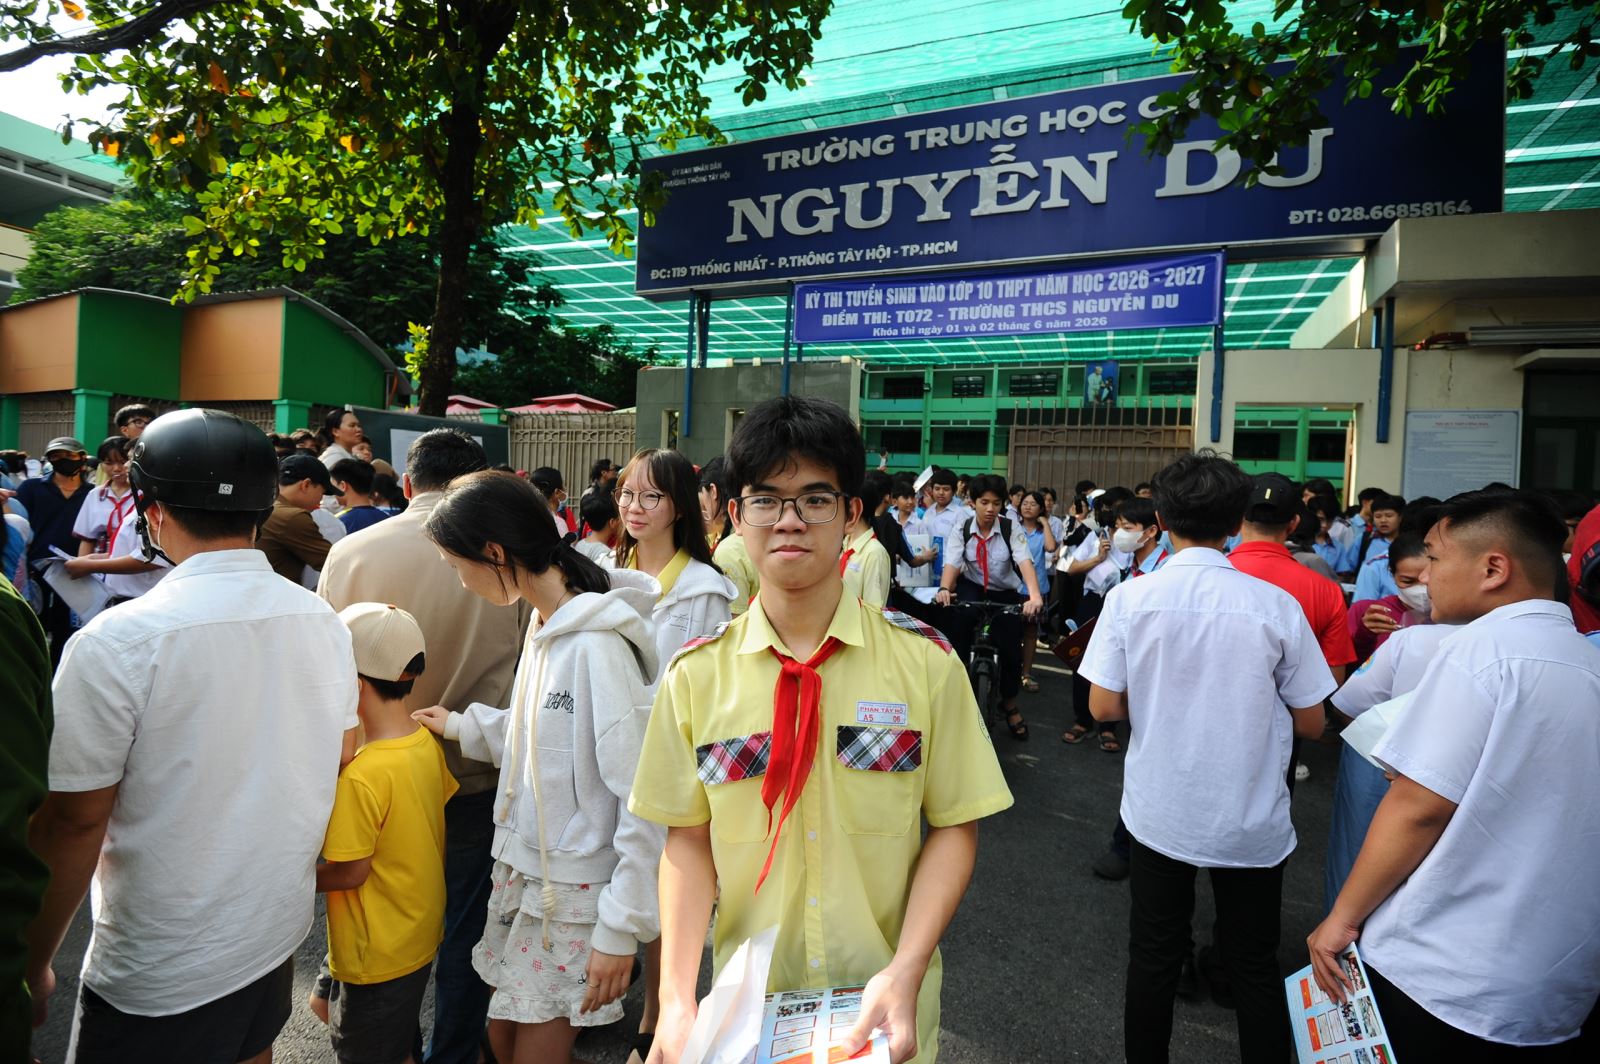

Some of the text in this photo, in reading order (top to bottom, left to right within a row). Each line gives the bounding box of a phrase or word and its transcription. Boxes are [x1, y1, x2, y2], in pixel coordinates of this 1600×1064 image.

[762, 134, 895, 172] TRƯỜNG
[904, 114, 1028, 150] TRUNG
[1040, 101, 1127, 134] HỌC
[726, 127, 1334, 243] NGUYỄN DU
[1288, 200, 1472, 225] ĐT: 028.66858164
[690, 258, 731, 276] THỐNG
[734, 254, 768, 272] NHẤT
[778, 251, 835, 268] P.THÔNG
[837, 247, 864, 263] TÂY
[866, 244, 891, 263] HỘI
[900, 240, 958, 257] TP.HCM
[805, 290, 821, 309] KỲ
[823, 291, 842, 308] THI
[846, 283, 883, 307] TUYỂN
[886, 287, 916, 305] SINH
[919, 282, 946, 303] VÀO
[949, 280, 974, 301] LỚP
[977, 281, 993, 300] 10
[997, 278, 1033, 298] THPT
[1036, 274, 1068, 296] NĂM
[1072, 273, 1104, 296] HỌC
[1108, 269, 1149, 291] 2026
[1164, 265, 1206, 287] 2027
[822, 308, 859, 327] ĐIỂM
[862, 311, 891, 325] THI:
[948, 303, 1015, 320] TRƯỜNG
[1020, 301, 1067, 317] THCS
[1072, 292, 1145, 314] NGUYỄN
[1151, 293, 1179, 309] DU
[873, 316, 1108, 337] Khóa thi ngày 01 và 02 tháng 6 năm 2026
